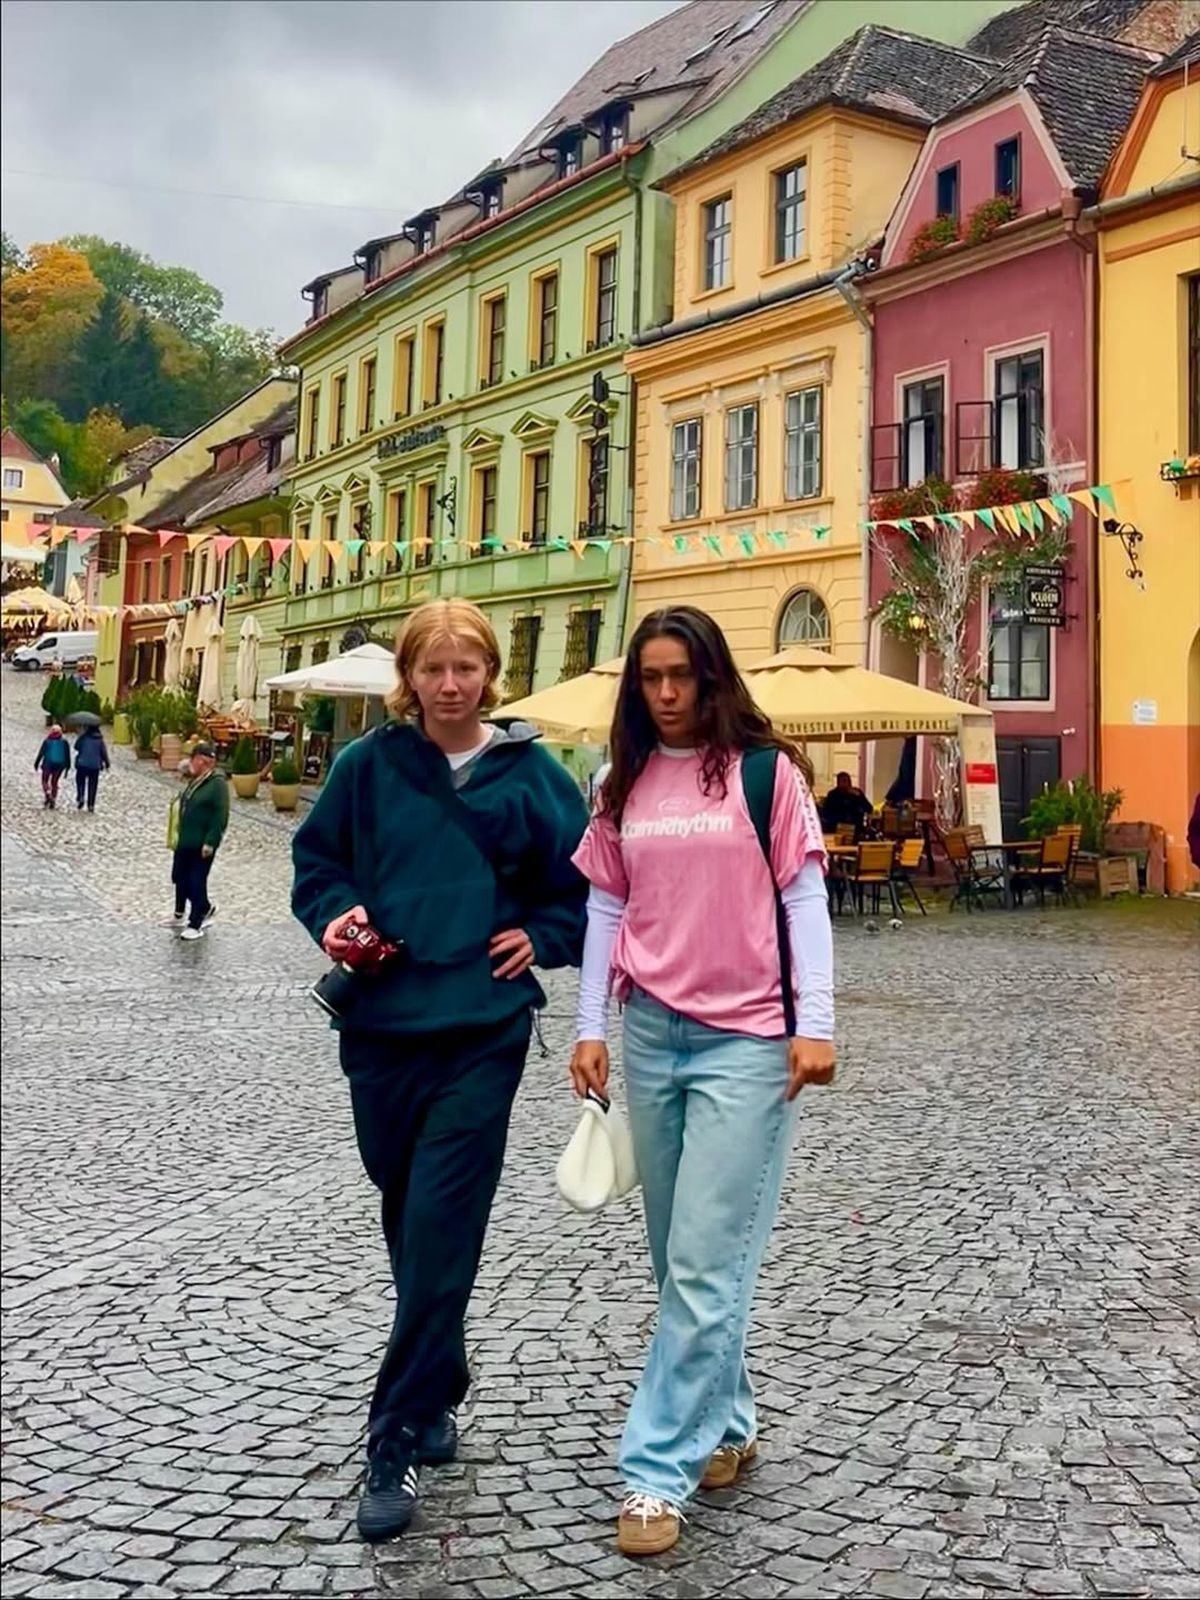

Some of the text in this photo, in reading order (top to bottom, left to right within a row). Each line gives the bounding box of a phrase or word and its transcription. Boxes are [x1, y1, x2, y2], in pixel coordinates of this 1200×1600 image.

[782, 719, 949, 734] POVESTEA MERGE MAI DEPARTE
